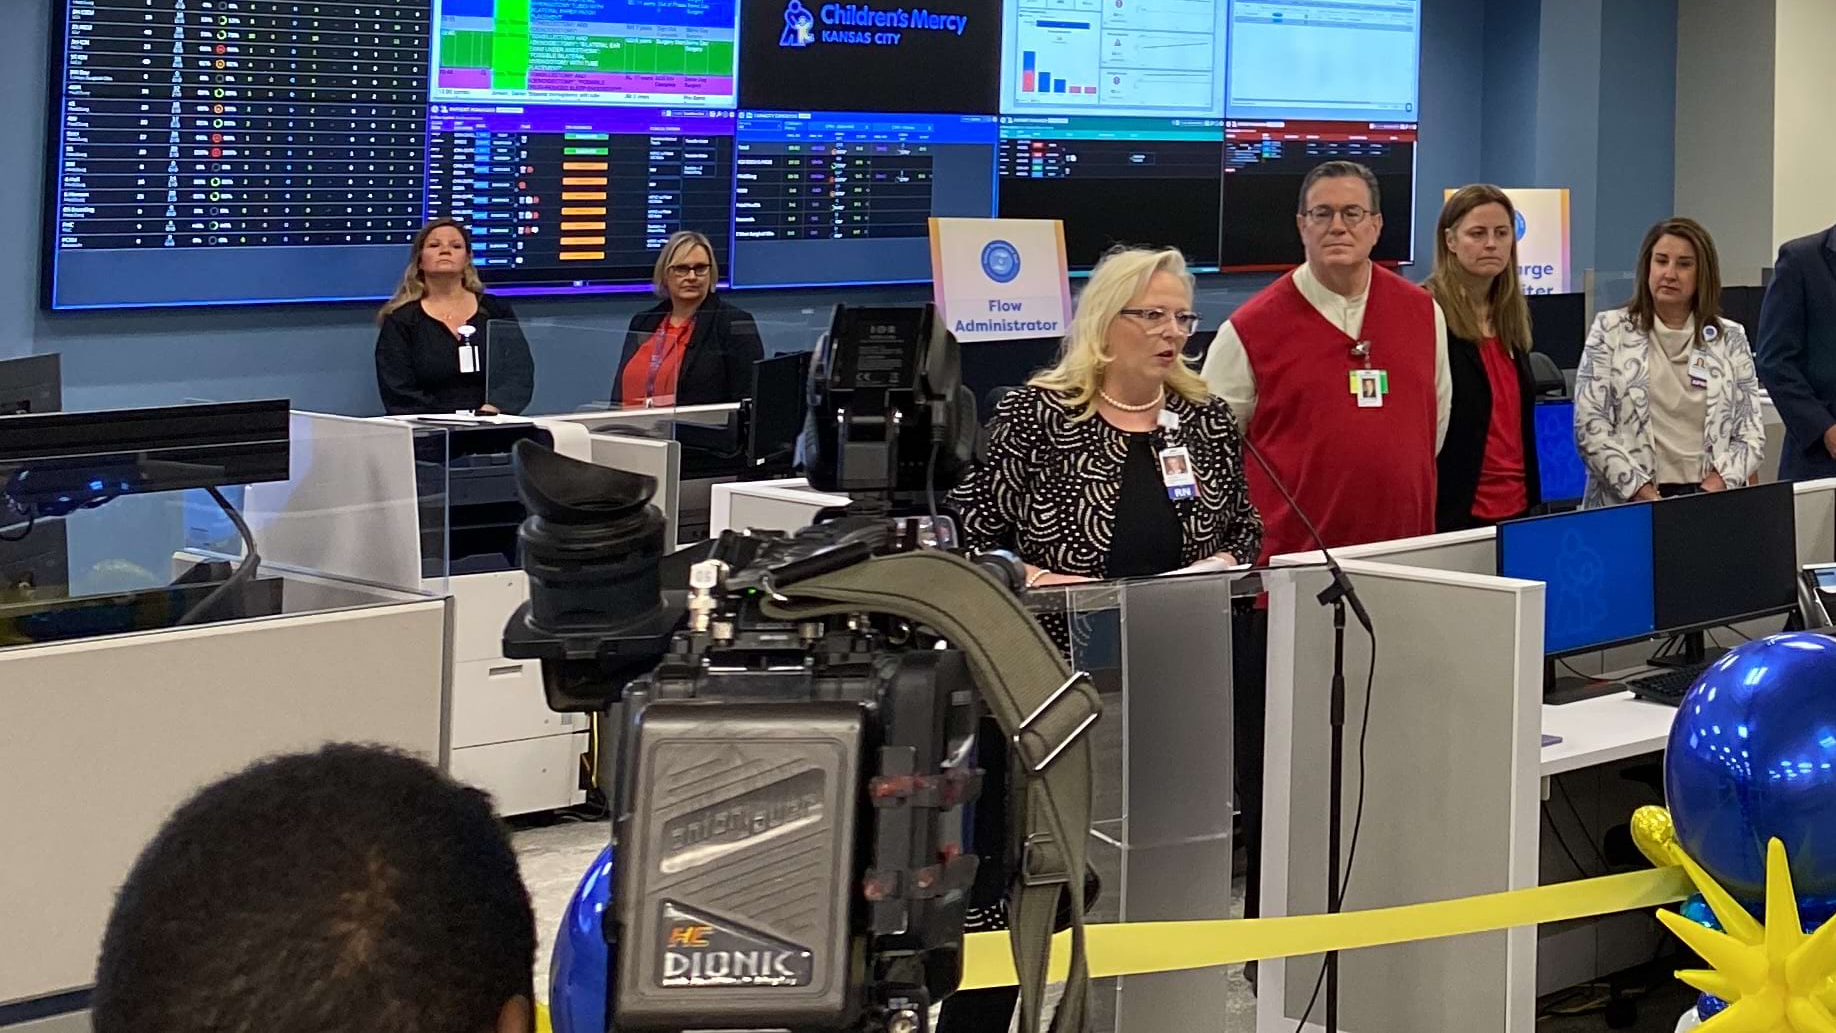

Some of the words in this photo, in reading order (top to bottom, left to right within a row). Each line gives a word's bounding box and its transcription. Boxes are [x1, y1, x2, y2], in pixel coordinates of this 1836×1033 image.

[820, 3, 909, 28] Children's
[910, 9, 968, 36] Mercy
[821, 30, 871, 44] KANSAS
[874, 32, 902, 45] CITY
[988, 299, 1022, 312] Flow
[954, 318, 1058, 333] Administrator
[1174, 487, 1192, 498] RN
